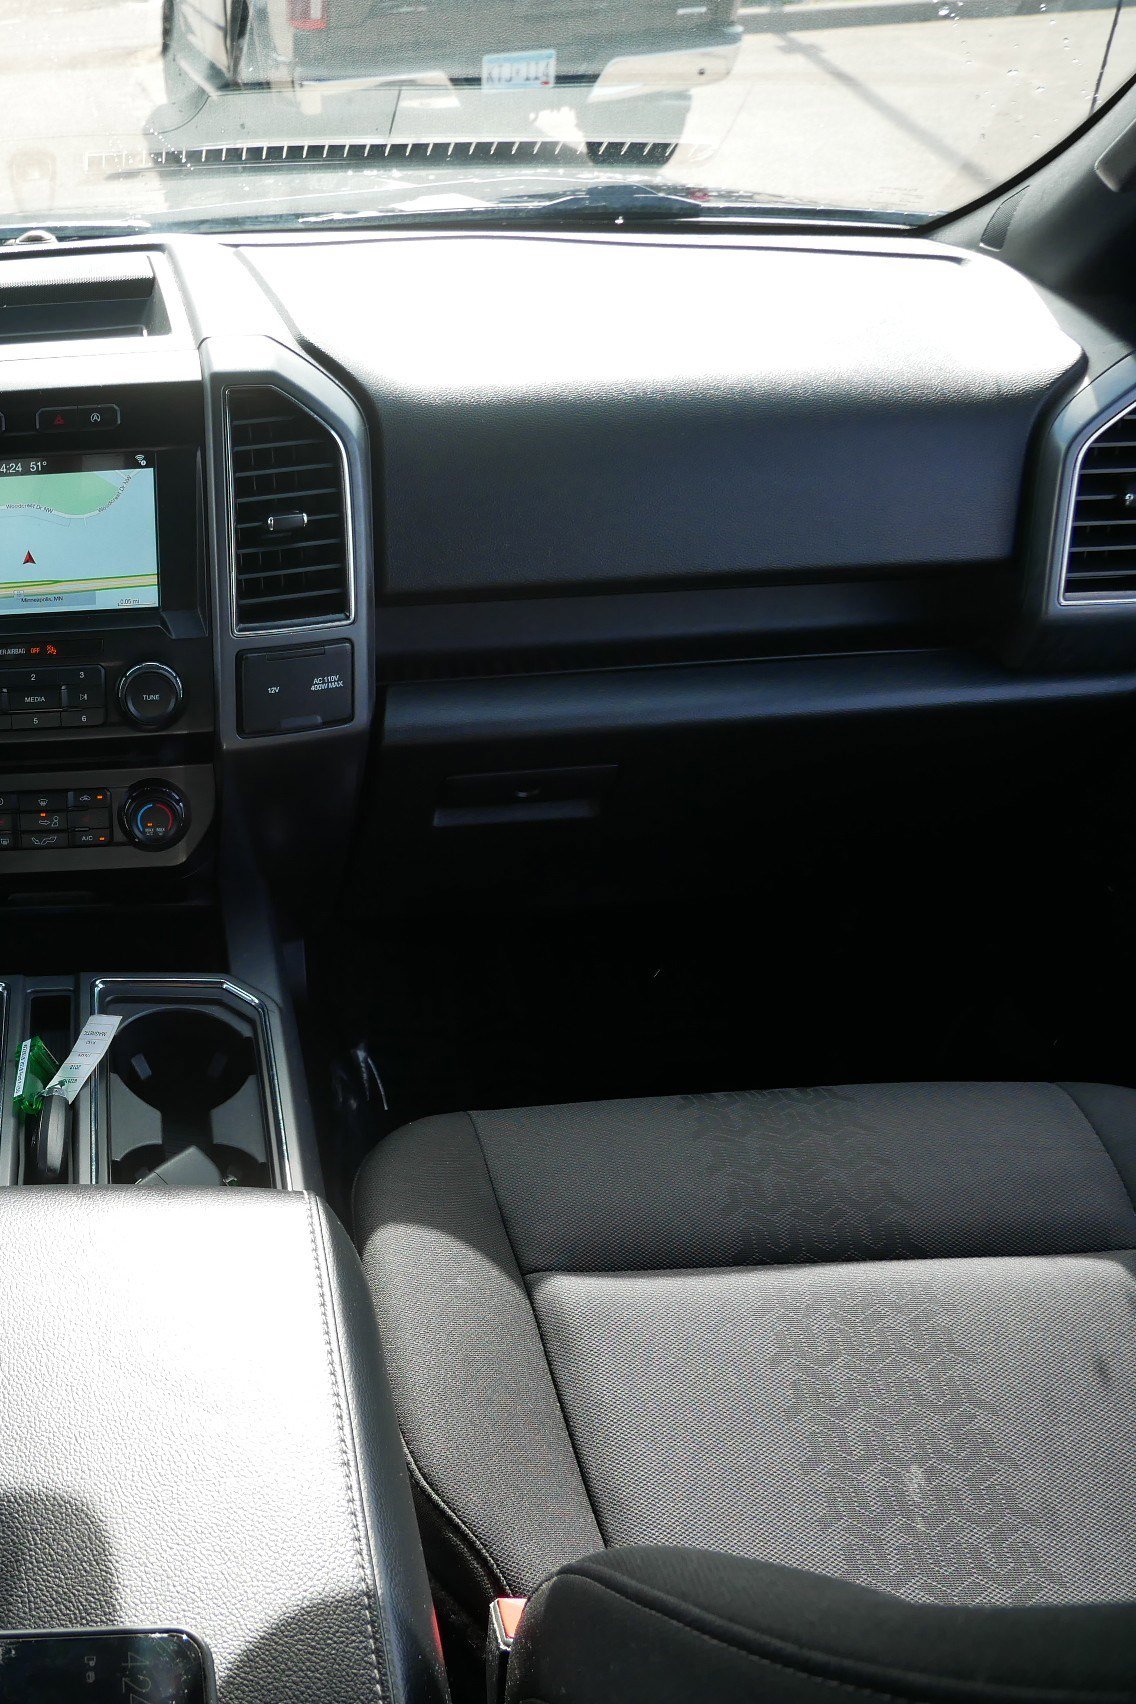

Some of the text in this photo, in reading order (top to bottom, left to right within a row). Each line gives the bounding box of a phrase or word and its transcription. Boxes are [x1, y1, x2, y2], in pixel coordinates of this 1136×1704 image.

[0, 461, 47, 474] 4:24 51°
[324, 675, 339, 683] 110V
[311, 681, 343, 691] 400W MAX
